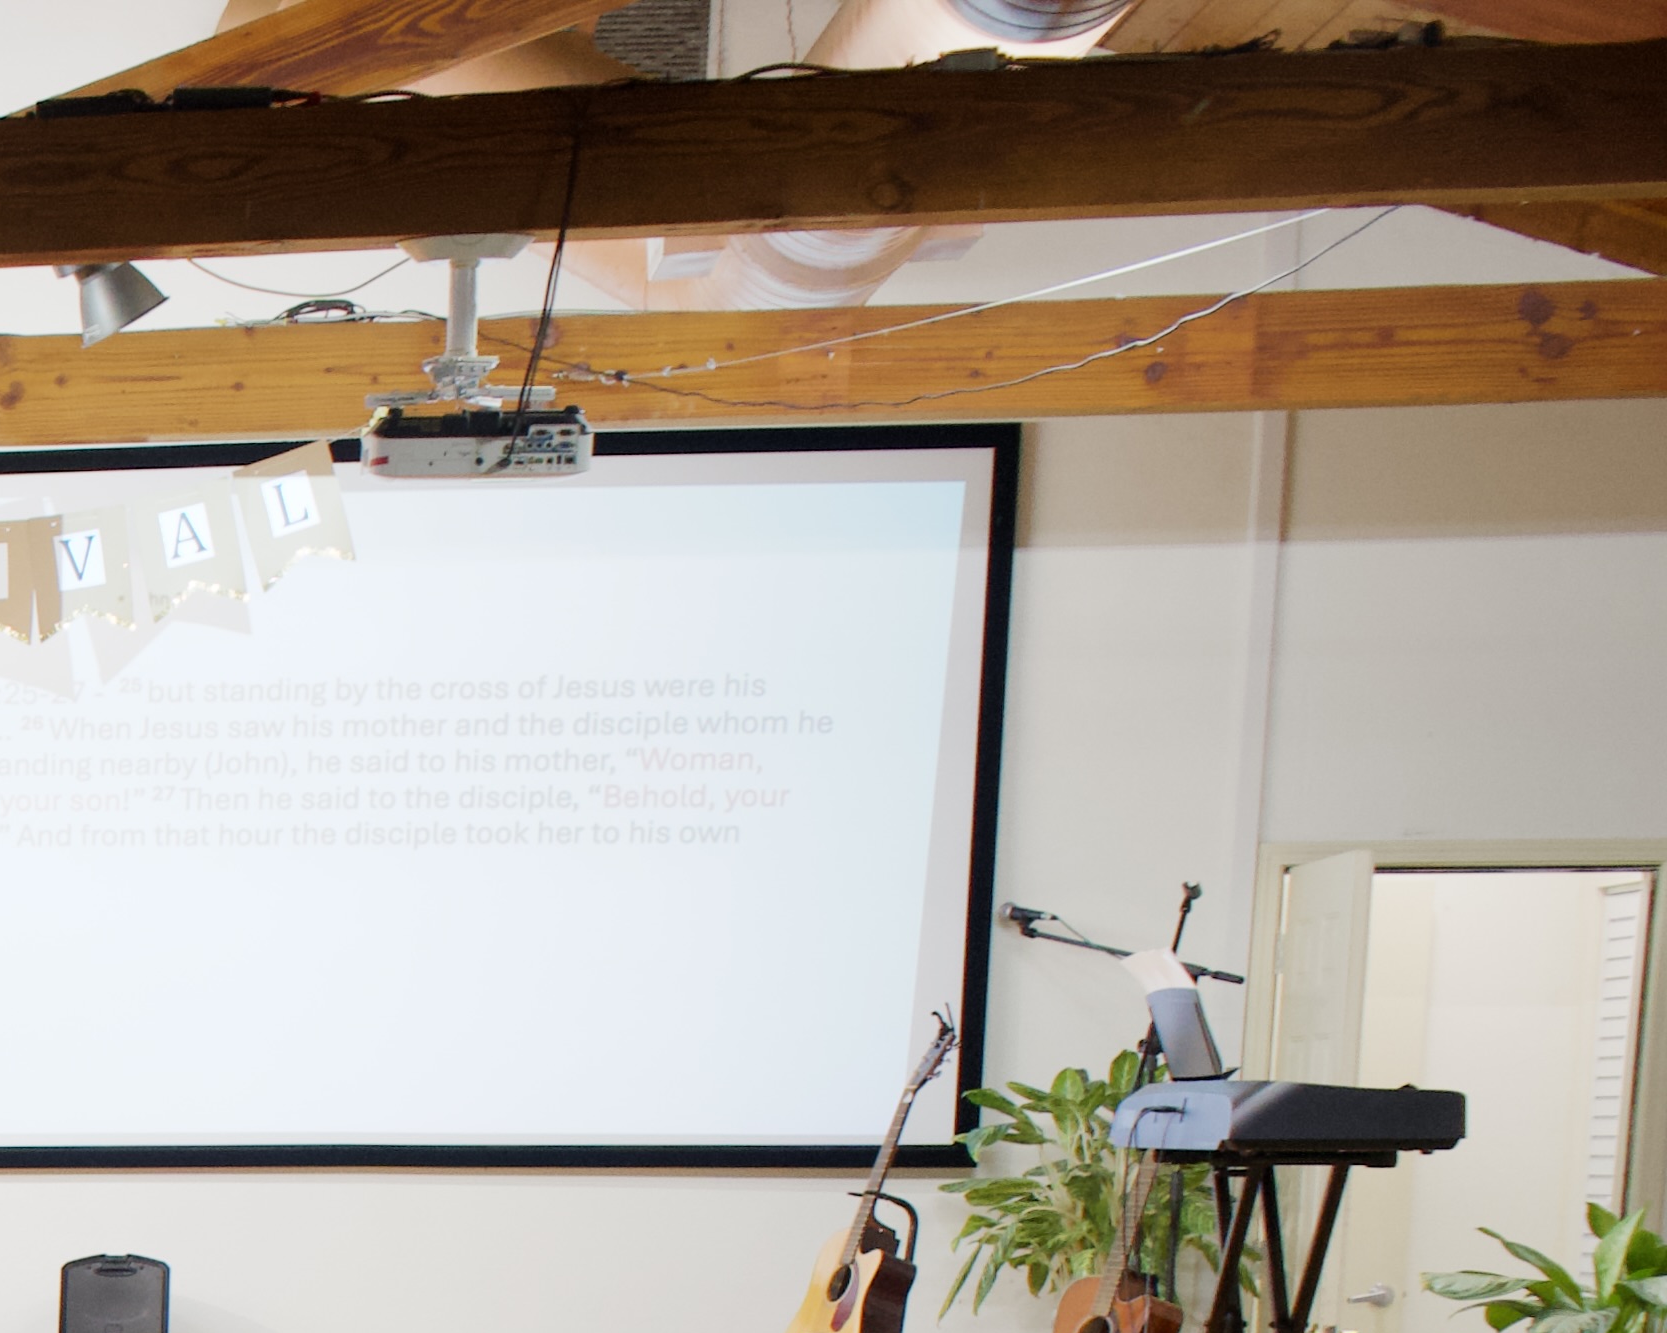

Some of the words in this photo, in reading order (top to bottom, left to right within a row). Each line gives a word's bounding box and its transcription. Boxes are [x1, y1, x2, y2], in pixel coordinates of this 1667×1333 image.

[148, 680, 194, 704] but
[204, 679, 327, 707] standing
[335, 676, 368, 706] by
[375, 677, 421, 701] the
[429, 678, 509, 701] cross
[518, 675, 548, 699] of
[553, 675, 635, 700] Jesus
[644, 677, 715, 698] were
[724, 673, 766, 698] his
[49, 717, 131, 741] When
[139, 716, 219, 740] Jesus
[227, 719, 285, 739] saw
[292, 714, 333, 738] his
[341, 713, 447, 739] mother
[455, 712, 510, 737] and
[518, 712, 564, 737] the
[572, 711, 687, 741] disciple
[697, 710, 789, 735] whom
[798, 710, 834, 735] he
[100, 753, 197, 780] nearby
[204, 751, 297, 778] (John),
[308, 751, 343, 775] he
[349, 748, 409, 773] said
[417, 750, 445, 773] to
[455, 748, 496, 773] his
[505, 748, 616, 775] mother,
[0, 792, 61, 818] your
[181, 786, 249, 811] Then
[258, 786, 292, 810] he
[301, 785, 359, 810] said
[368, 787, 396, 810] to
[405, 785, 449, 810] the
[459, 785, 579, 814] disciple,
[724, 785, 790, 814] your
[17, 824, 72, 848] And
[80, 823, 145, 848] from
[155, 823, 208, 847] that
[219, 822, 282, 846] hour
[292, 822, 336, 846] the
[343, 822, 457, 850] disciple
[465, 821, 529, 845] took
[537, 821, 583, 845] her
[592, 823, 619, 845] to
[629, 820, 671, 845] his
[679, 823, 740, 845] own
